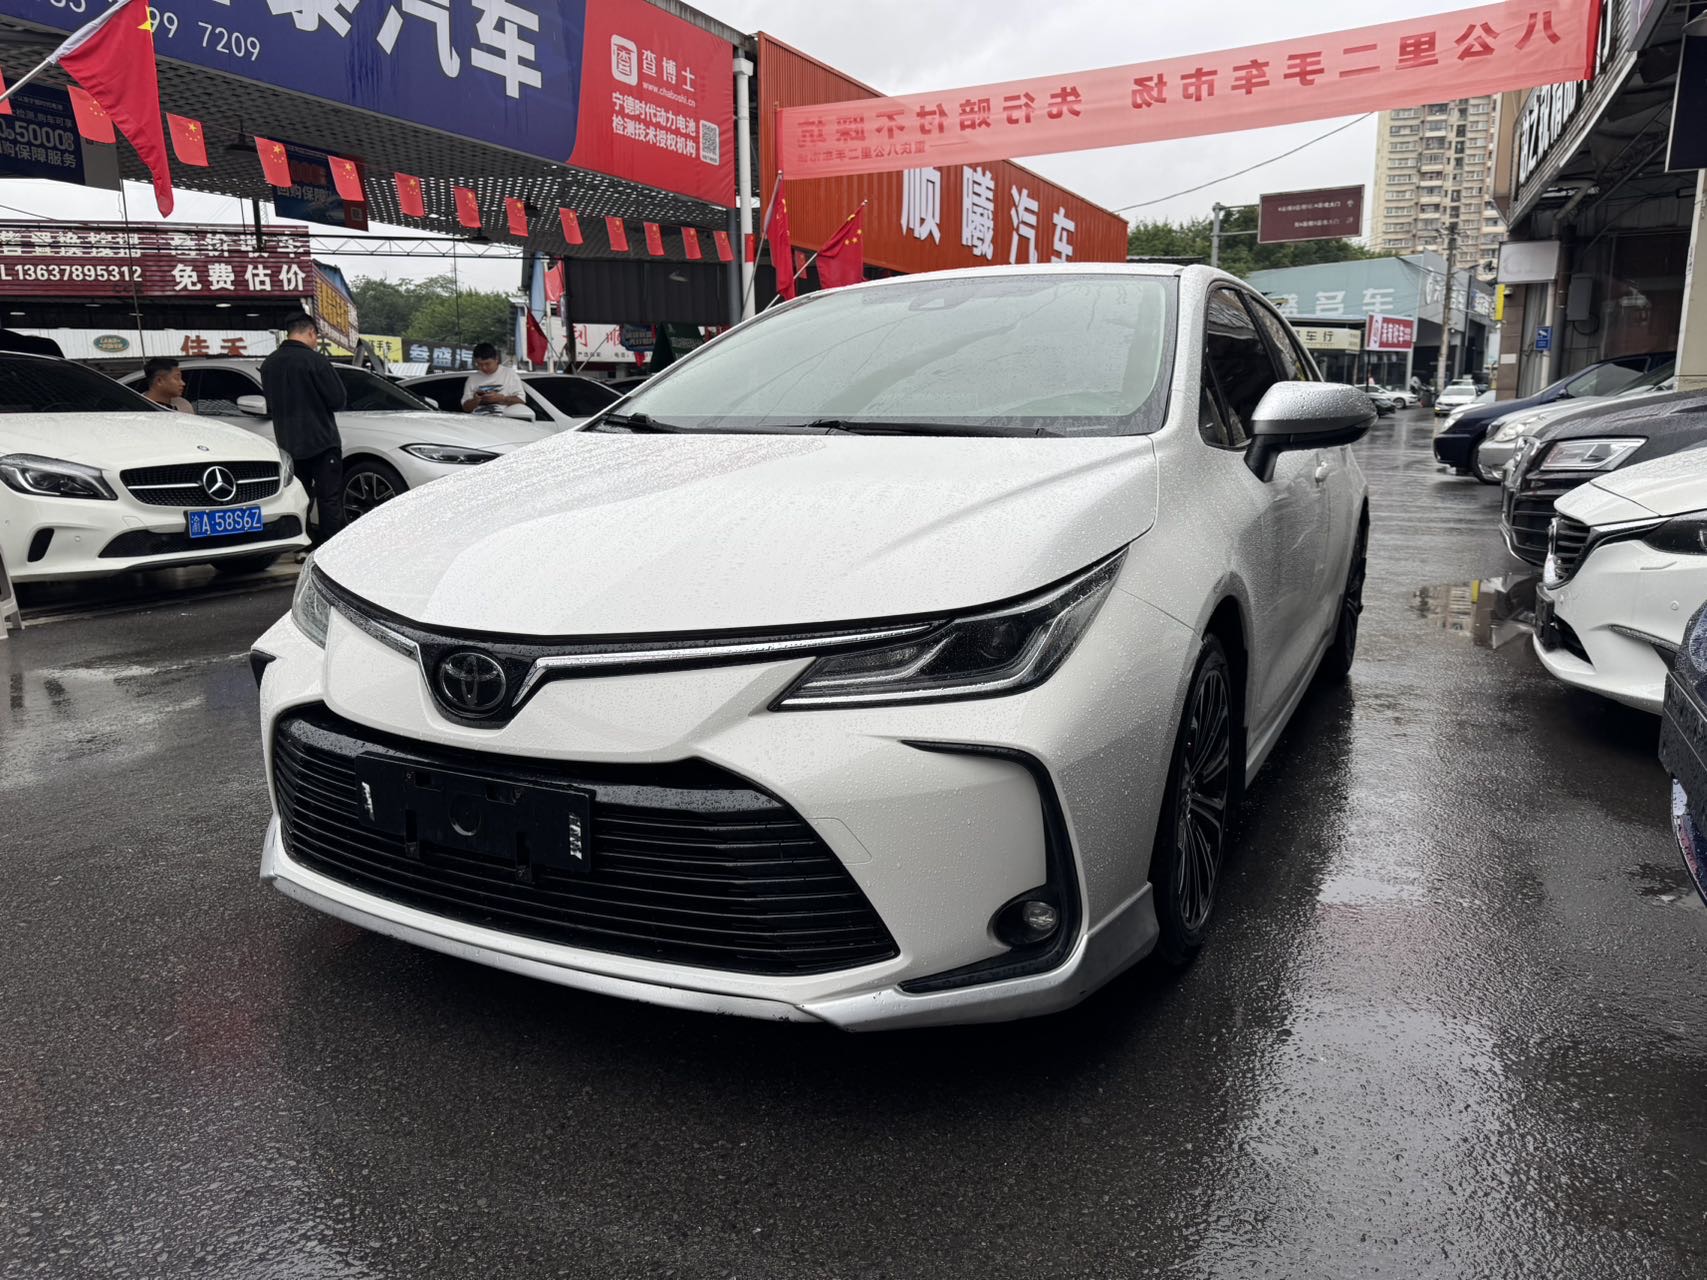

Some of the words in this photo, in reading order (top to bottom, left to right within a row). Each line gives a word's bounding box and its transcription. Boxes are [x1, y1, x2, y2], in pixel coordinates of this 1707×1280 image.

[198, 21, 261, 61] 7209
[641, 49, 695, 92] 查博士
[612, 91, 697, 137] 宁德时代动力电池
[0, 140, 77, 169] 购保障服务
[612, 113, 697, 158] 检测技术授权机构
[171, 263, 306, 291] 免费估价
